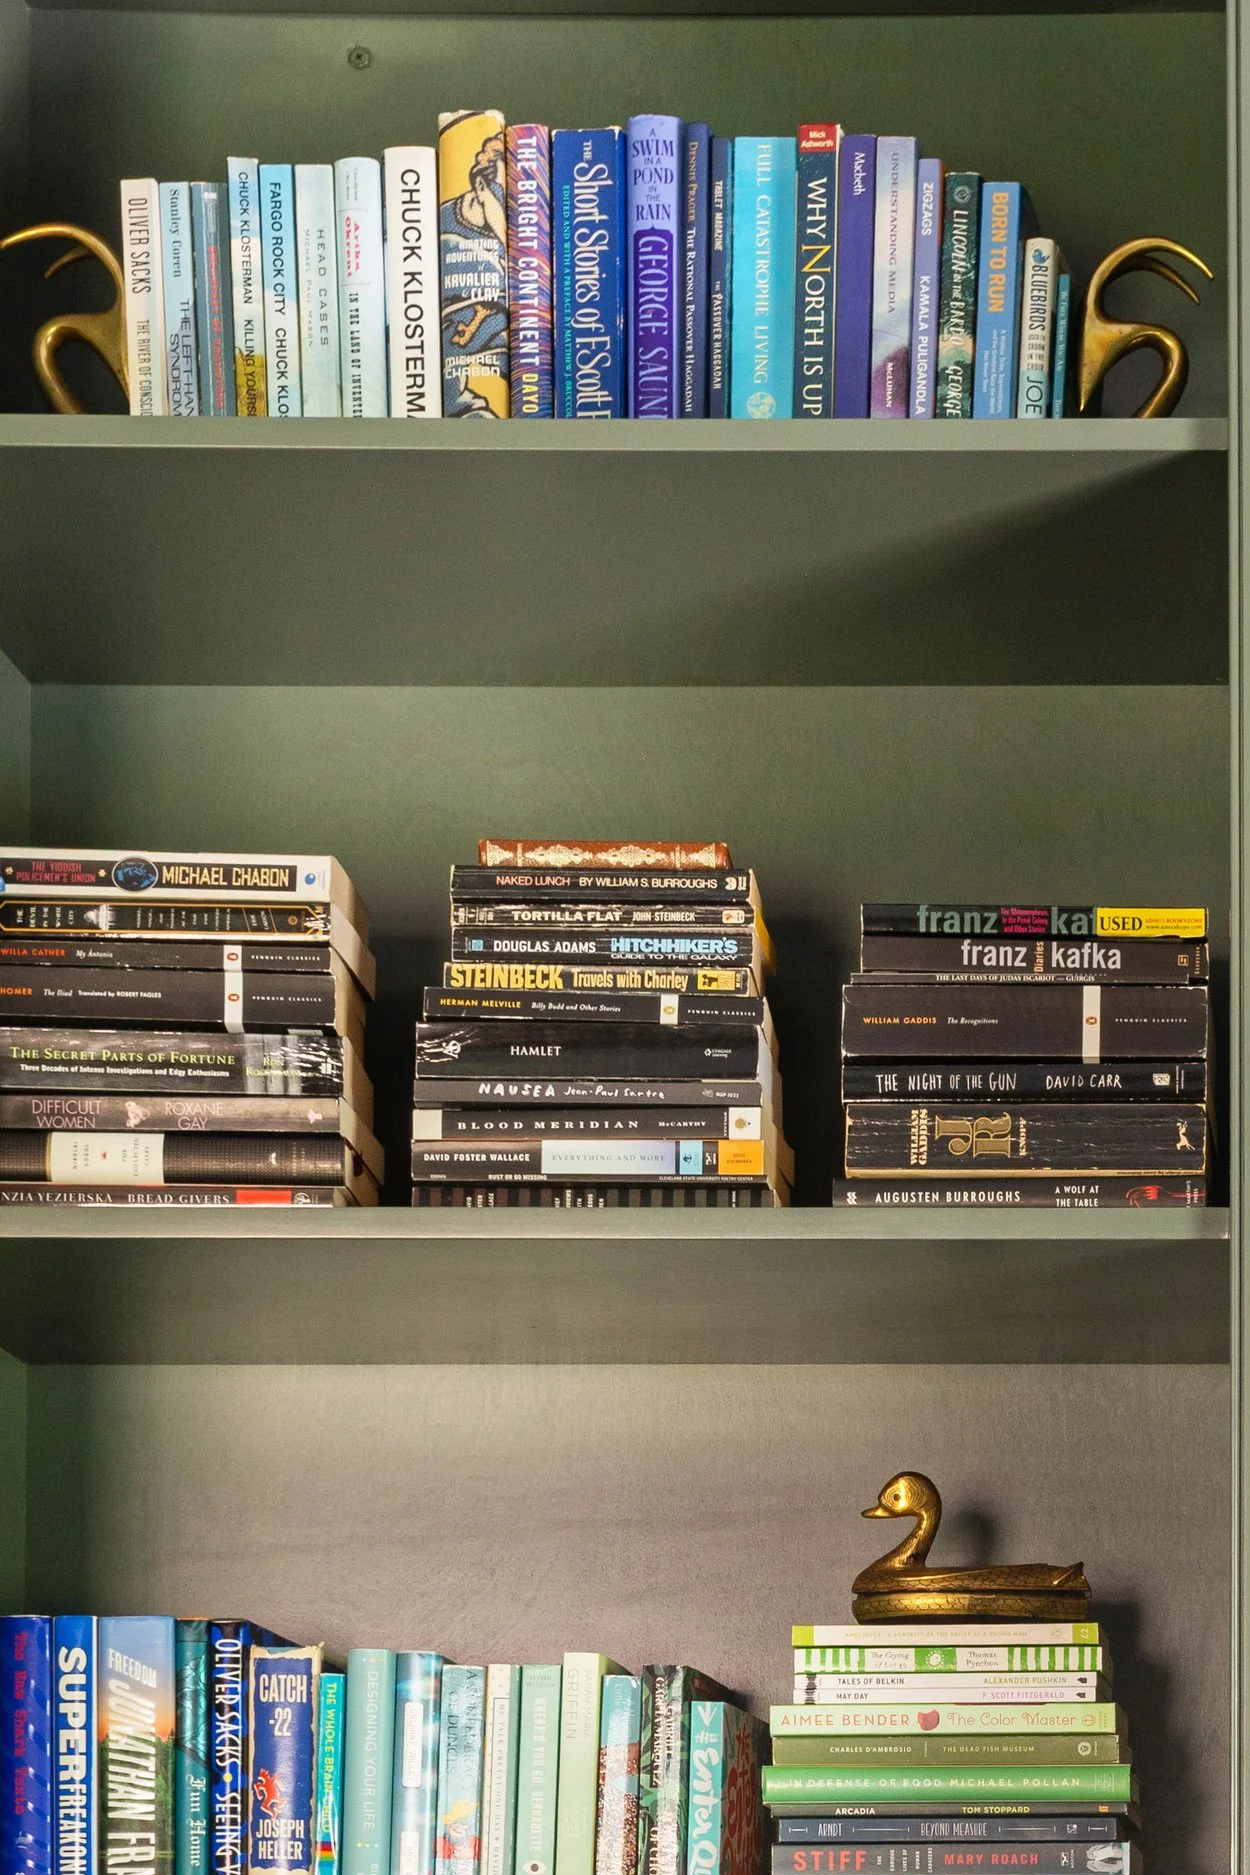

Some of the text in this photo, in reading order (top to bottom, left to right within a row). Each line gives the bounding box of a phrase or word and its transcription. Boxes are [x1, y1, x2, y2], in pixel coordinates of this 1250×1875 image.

[128, 197, 151, 294] OLIVER SACKS
[515, 136, 539, 412] THE BRIGHT CONTINENT DAYO
[801, 178, 830, 416] WHY NORTH IS UP
[162, 867, 289, 887] MICHAEL CHABON
[496, 876, 717, 888] NAKED LUNCH BY WILLIAM S. BURROUGHS
[1100, 917, 1142, 931] USED
[494, 938, 738, 952] DOUGLAS ADAMS HITCHHIKER'S
[961, 940, 1121, 969] franz kafka
[450, 965, 688, 991] STEINBECK Travels with Charley
[511, 1046, 561, 1056] HAMLET
[876, 1073, 1121, 1091] THE NIGHT OF THE GUN DAVID CARR
[215, 1639, 241, 1704] OLIVER
[260, 1674, 307, 1704] CATCH
[107, 1679, 156, 1821] JONATHAN
[215, 1709, 241, 1766] SACKS
[215, 1794, 241, 1856] SEEING
[256, 1821, 305, 1840] JOSEPH
[259, 1842, 303, 1861] HELLER
[793, 1850, 1038, 1871] STIFF MARY ROACH
